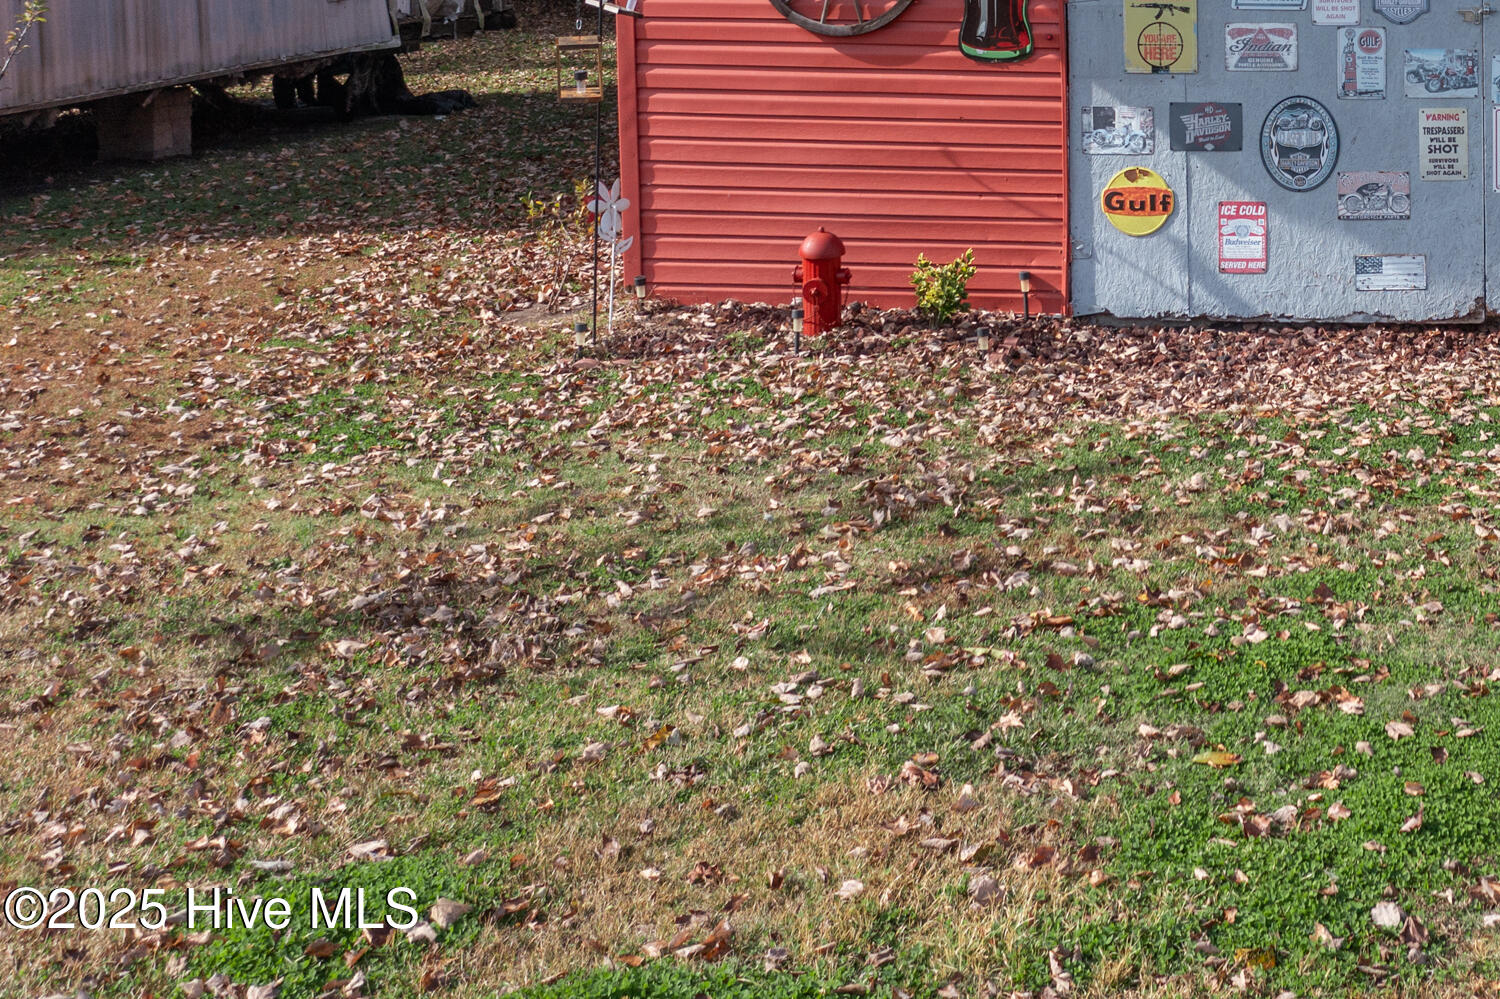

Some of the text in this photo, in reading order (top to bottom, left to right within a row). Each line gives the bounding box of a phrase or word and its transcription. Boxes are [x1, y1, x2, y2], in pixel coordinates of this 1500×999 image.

[1143, 34, 1177, 43] YOU ARE
[1360, 36, 1380, 48] GULF
[1229, 37, 1292, 52] Indian
[1143, 46, 1177, 60] HERE
[1425, 113, 1460, 121] WARNING
[1423, 127, 1465, 135] TRESPASSERS
[1427, 144, 1459, 154] SHOT
[1104, 191, 1171, 211] Gulf
[1220, 204, 1265, 216] ICE COLD
[1220, 261, 1266, 269] SERVED HERE
